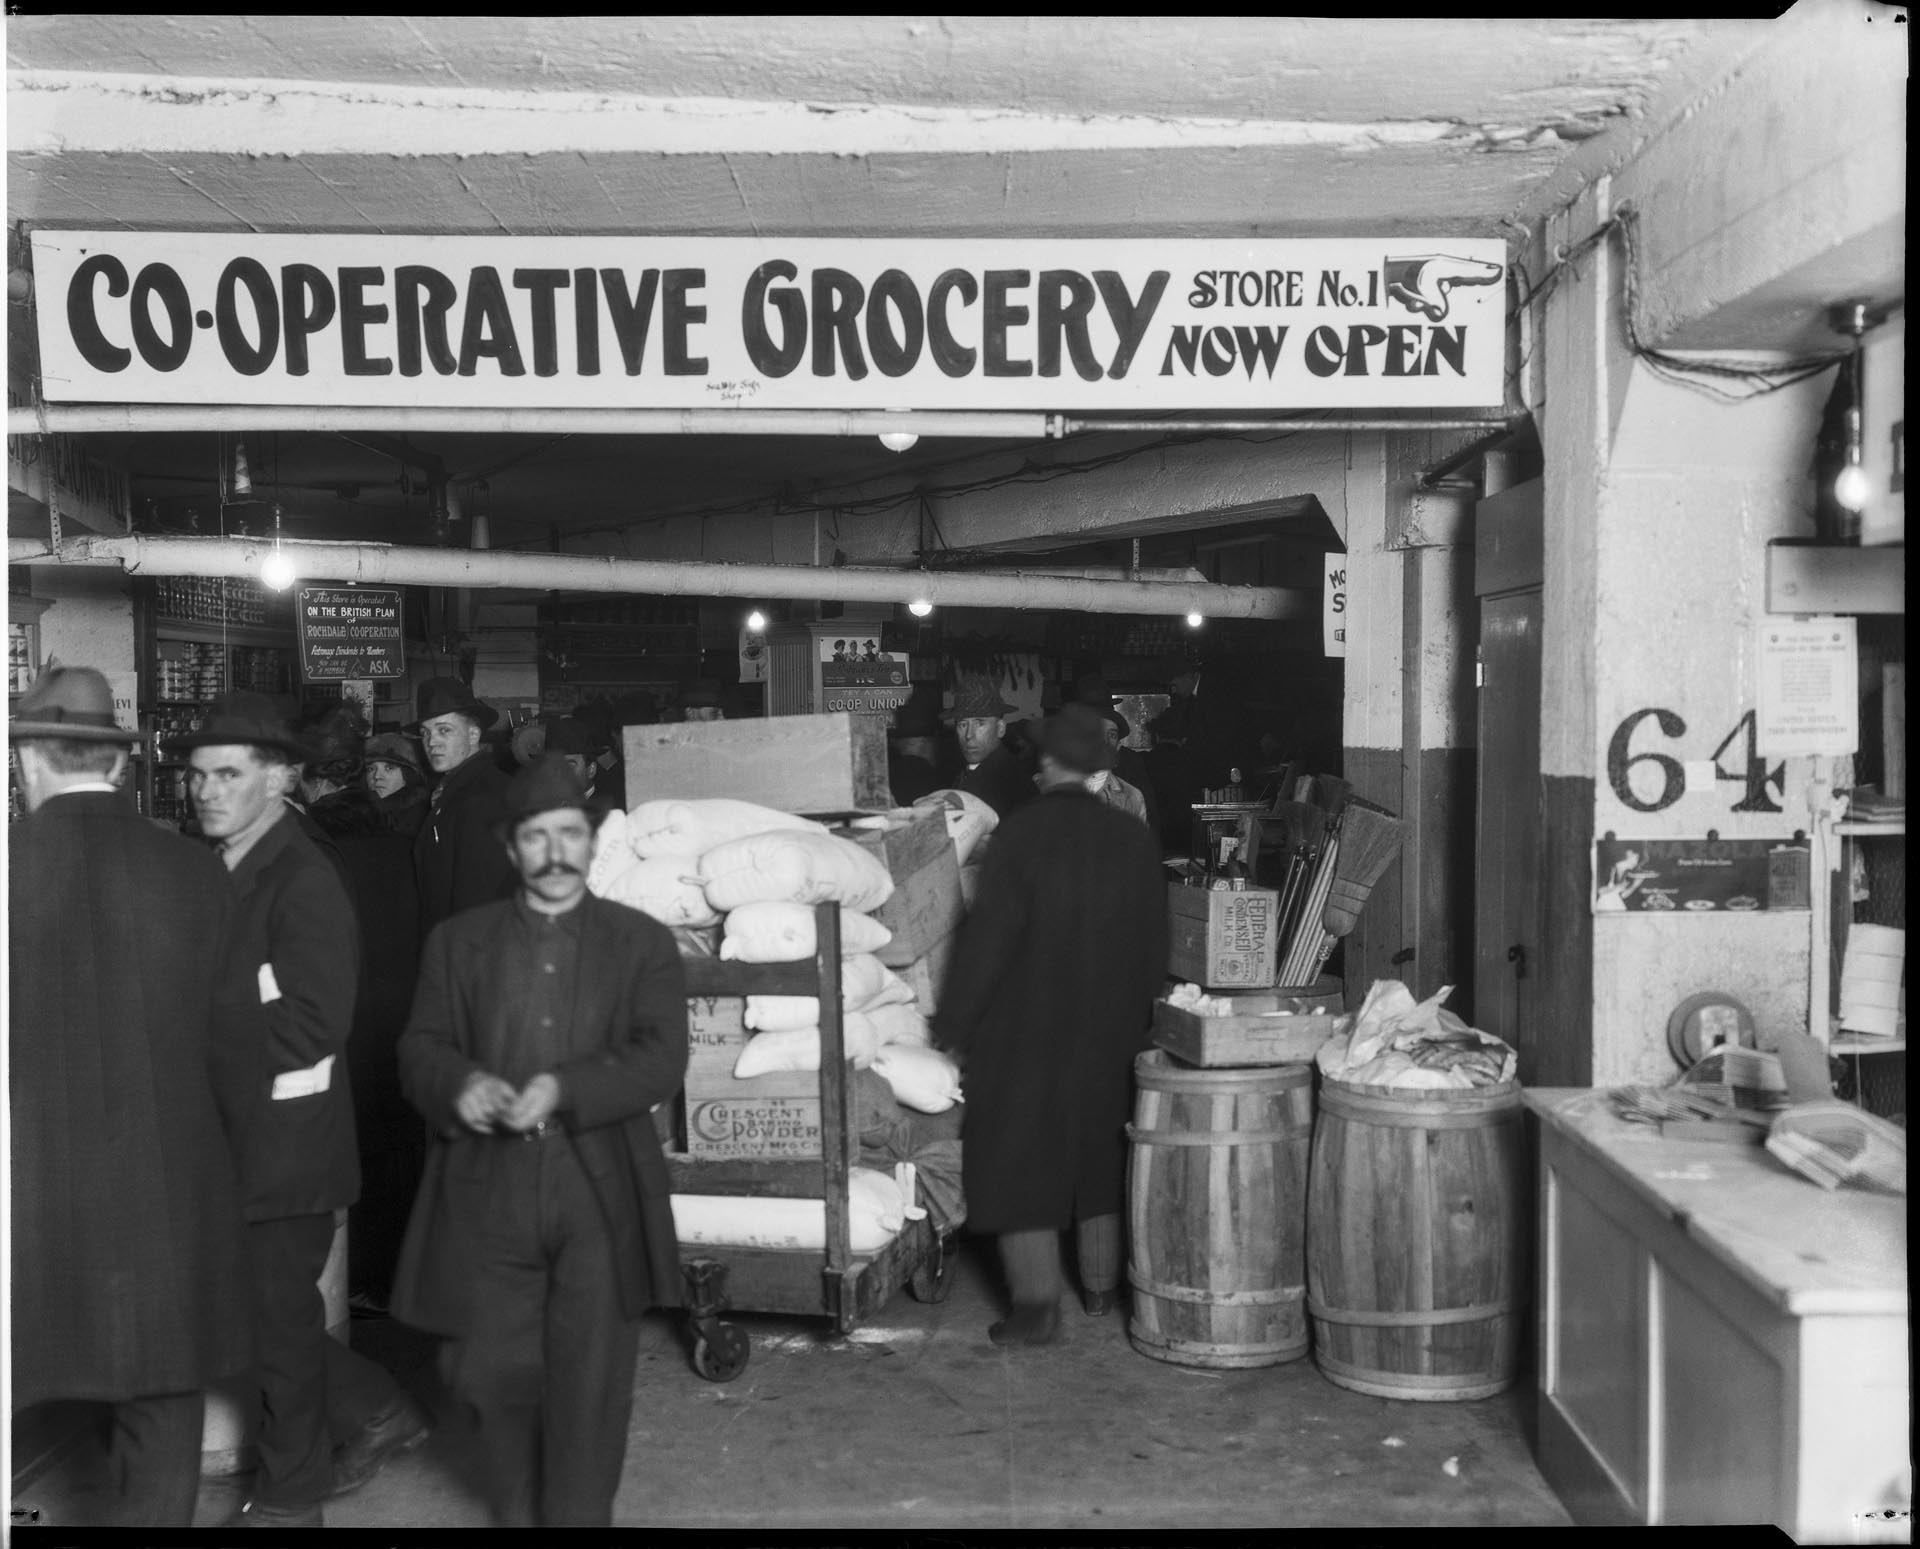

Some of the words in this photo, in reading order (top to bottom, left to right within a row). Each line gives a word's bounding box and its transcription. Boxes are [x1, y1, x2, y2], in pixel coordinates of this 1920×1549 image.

[1188, 270, 1303, 308] STORE
[742, 260, 1170, 381] GROCERY
[1159, 326, 1289, 379] NOW
[1305, 325, 1468, 378] OPEN
[313, 591, 330, 603] This
[331, 594, 348, 604] Store
[357, 595, 386, 606] Operated
[307, 606, 318, 617] ON
[321, 607, 336, 617] THE
[340, 607, 371, 617] BRITISH
[375, 607, 395, 617] PLAN
[307, 625, 347, 638] ROCHDALE
[369, 660, 391, 674] ASK
[869, 698, 905, 711] UNION
[1608, 708, 1786, 813] 64
[1224, 906, 1234, 932] MILK
[1233, 897, 1251, 951] CONDENSED
[689, 1033, 727, 1046] MILK
[709, 1103, 805, 1124] CRESCENT
[732, 1121, 818, 1141] POWDER
